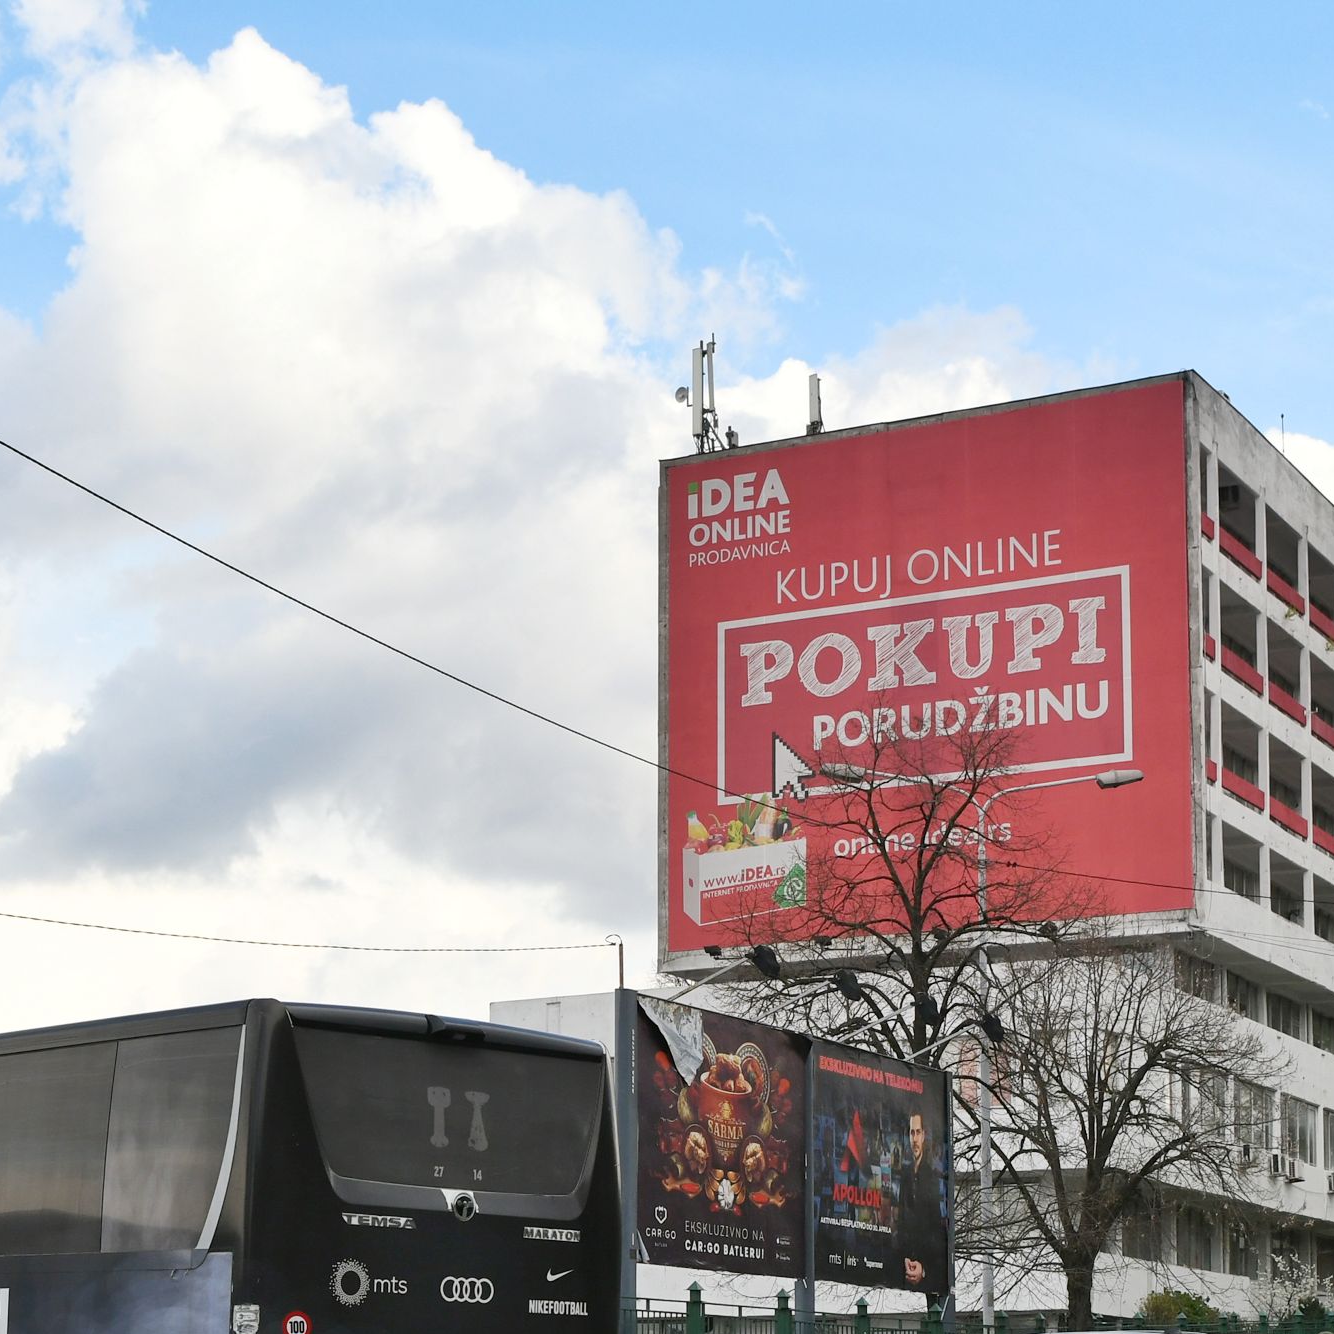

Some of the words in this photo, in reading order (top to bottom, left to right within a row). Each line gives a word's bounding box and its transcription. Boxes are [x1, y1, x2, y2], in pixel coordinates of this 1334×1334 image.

[688, 509, 791, 547] ONLINE
[689, 539, 791, 567] PRODAVNICA
[776, 554, 891, 604] KUPUJ
[907, 529, 1061, 585] ONLINE
[739, 596, 1106, 707] POKUPI
[812, 679, 1109, 750] PORUDŽBINU
[703, 887, 735, 899] INTERNET
[708, 1119, 743, 1139] SARMA
[433, 1166, 444, 1177] 27
[473, 1169, 482, 1181] 14
[833, 1183, 881, 1208] APOLLON
[342, 1212, 417, 1230] TEMSA
[522, 1226, 581, 1242] MARATON
[645, 1227, 676, 1240] CAR:GO
[684, 1220, 749, 1240] EKSKLUZIVNO
[752, 1230, 765, 1241] NA
[684, 1239, 720, 1254] CAR:GO
[829, 1253, 842, 1264] mts
[374, 1277, 408, 1294] mts
[528, 1299, 588, 1316] NIKEFOOTBALL
[289, 1320, 305, 1334] 100
